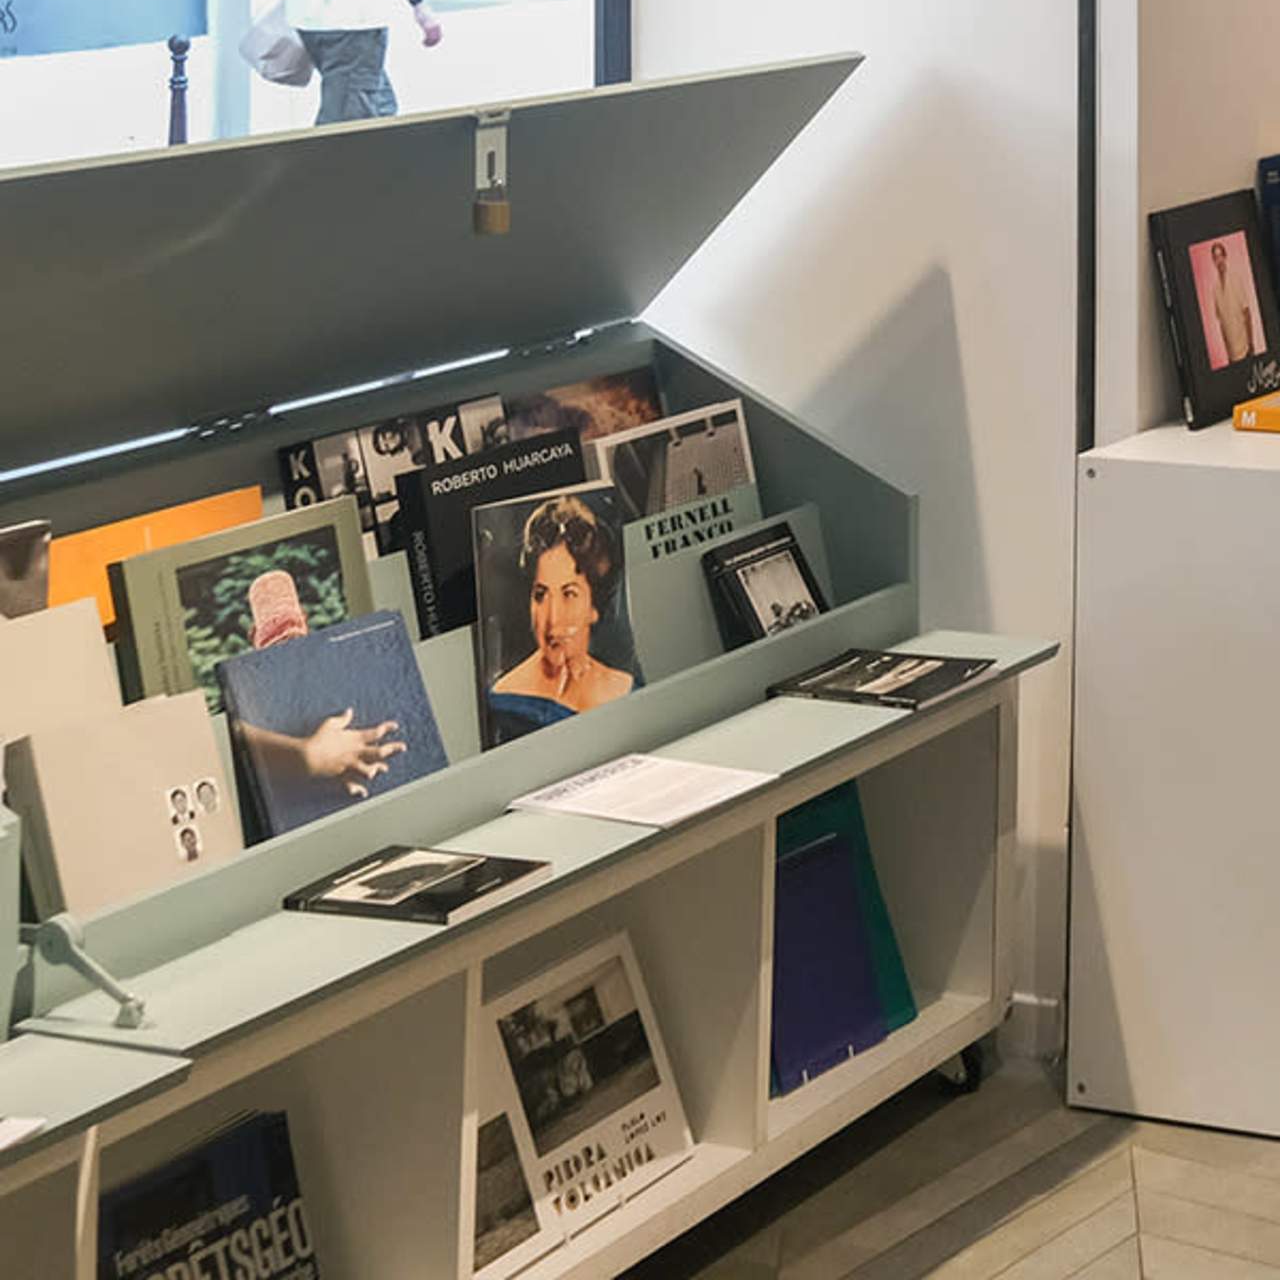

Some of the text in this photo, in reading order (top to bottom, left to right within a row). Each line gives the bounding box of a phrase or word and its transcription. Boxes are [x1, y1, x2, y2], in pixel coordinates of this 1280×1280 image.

[430, 441, 574, 496] ROBERTO HUARCAYA
[644, 496, 734, 542] FERNELL
[651, 518, 735, 560] FRANCO
[543, 1143, 608, 1194] PIEDRA
